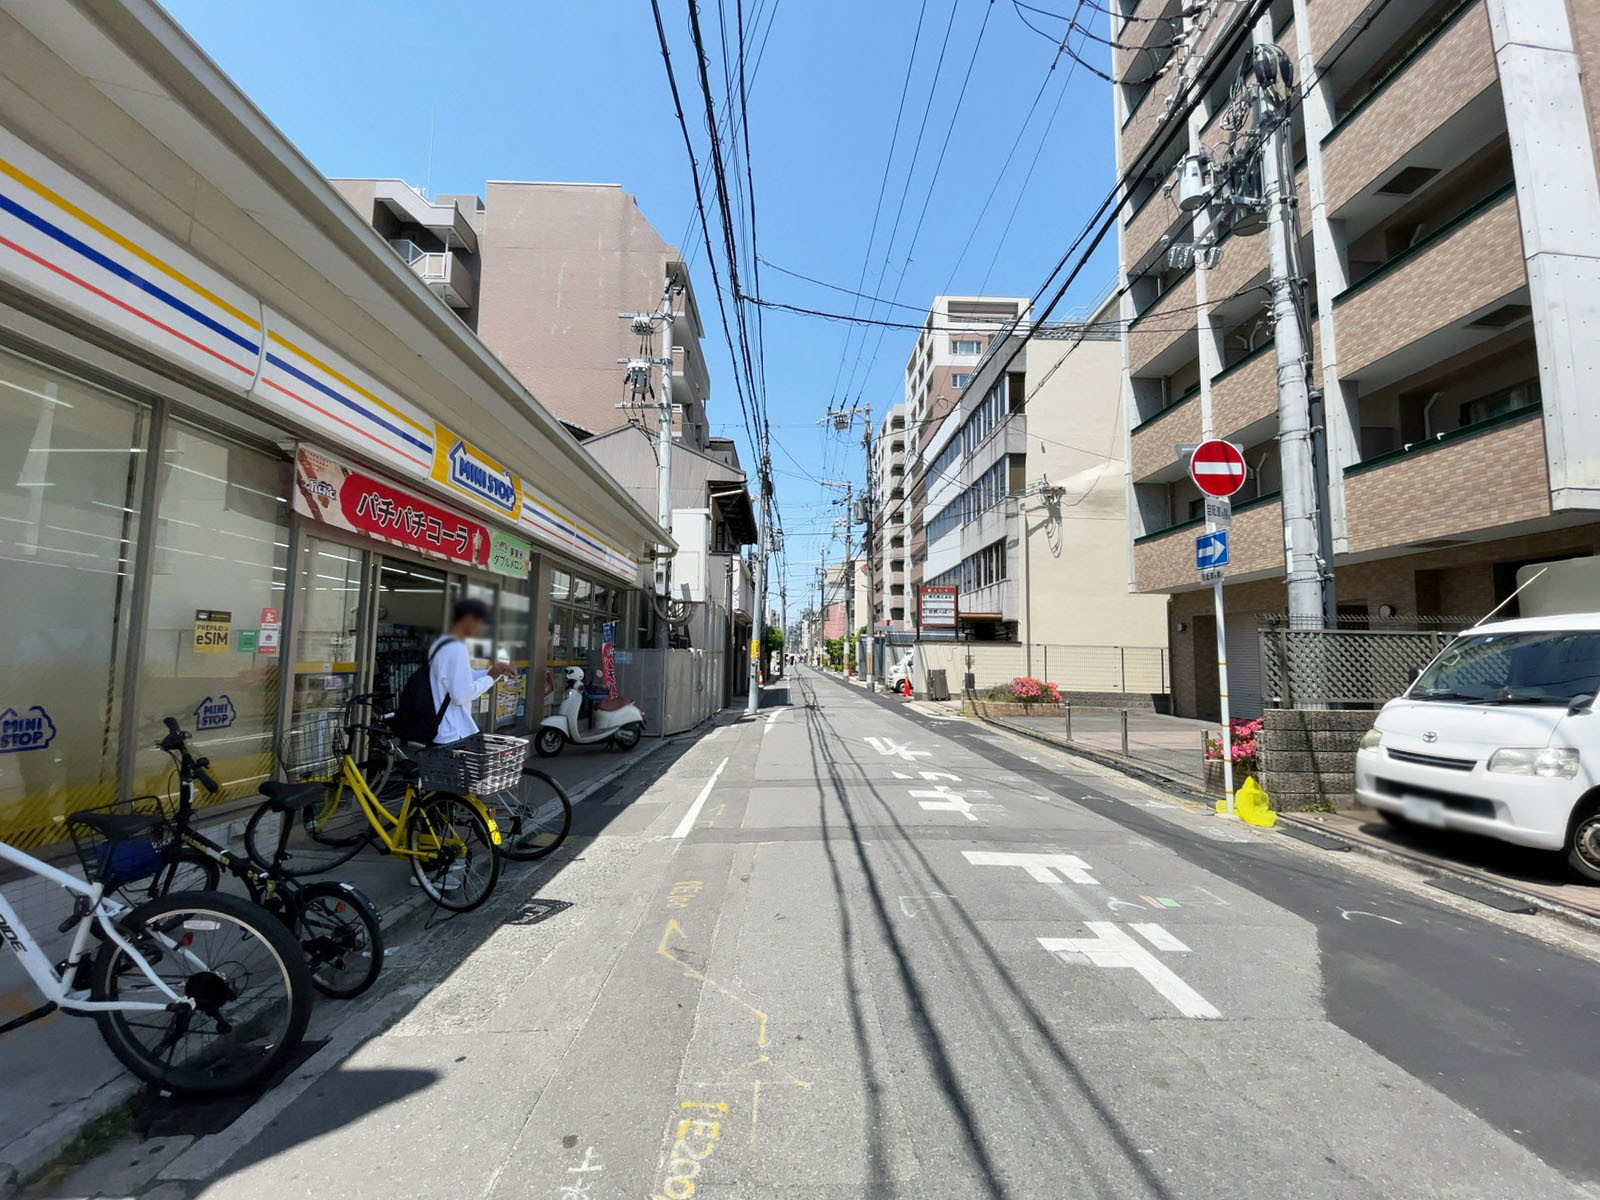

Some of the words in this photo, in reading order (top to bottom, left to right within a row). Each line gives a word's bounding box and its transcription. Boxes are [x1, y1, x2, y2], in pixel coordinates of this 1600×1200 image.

[459, 456, 487, 489] MINI
[487, 474, 514, 502] STOP
[356, 491, 469, 554] パチパチコーラ
[196, 632, 228, 645] eSIM
[203, 704, 228, 715] MINI
[2, 717, 43, 733] MINI
[202, 714, 228, 726] STOP
[0, 731, 44, 748] STOP
